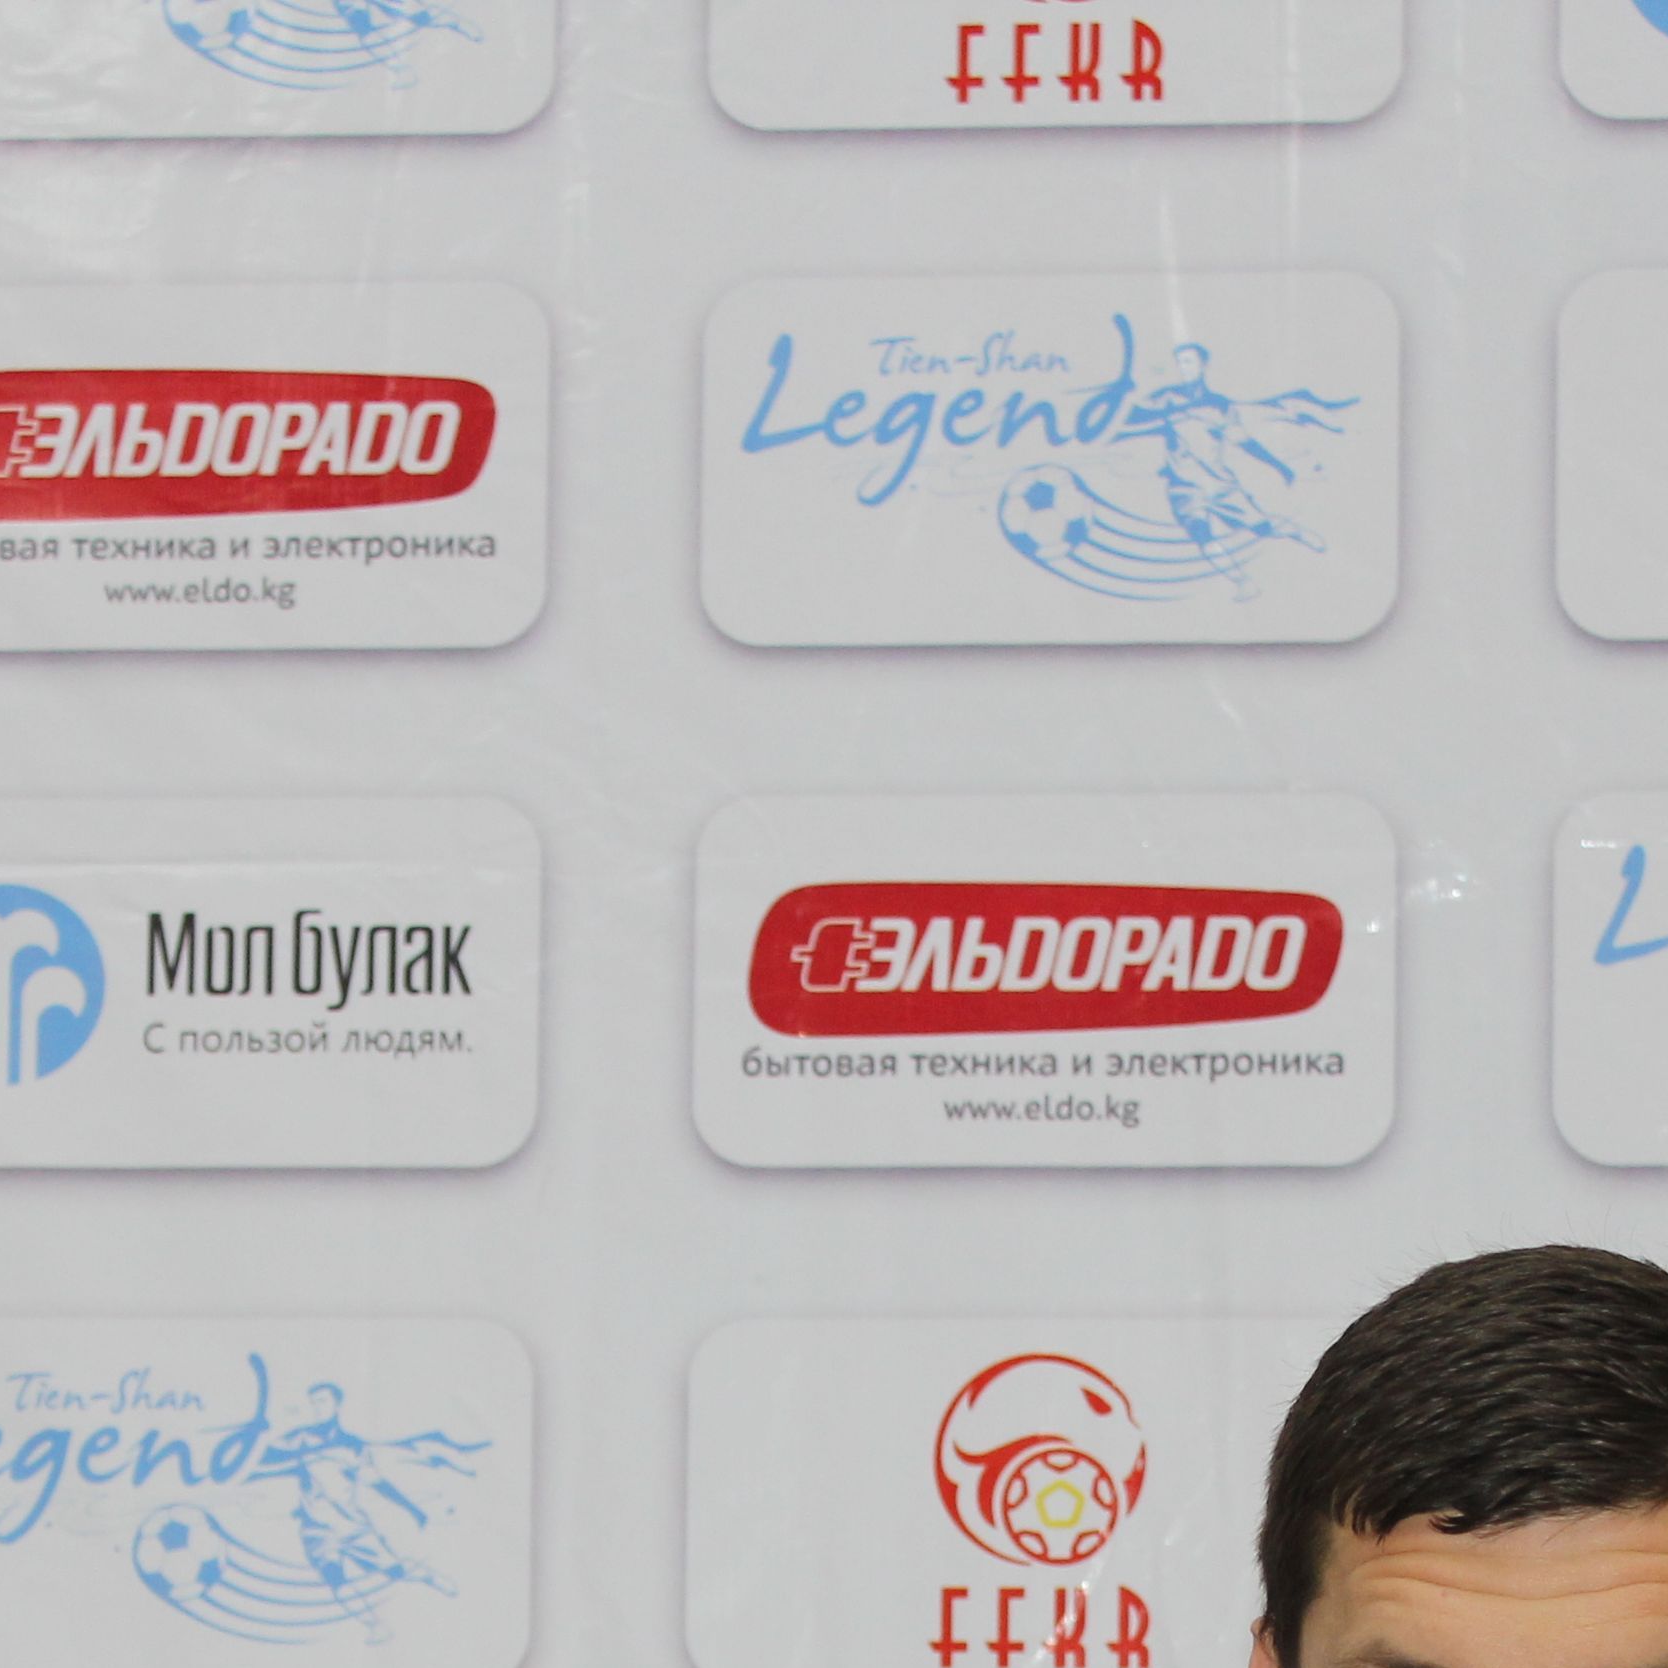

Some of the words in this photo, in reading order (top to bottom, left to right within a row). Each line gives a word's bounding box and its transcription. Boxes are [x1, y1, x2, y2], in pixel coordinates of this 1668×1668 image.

[946, 19, 1164, 104] FFKR
[870, 331, 1070, 377] Tien-Shan
[741, 313, 1135, 506] Legend
[71, 537, 218, 561] техника
[229, 538, 251, 559] и
[262, 535, 497, 566] электроника
[103, 576, 297, 610] www.eldo.kg
[147, 911, 275, 996] Мол
[142, 1021, 166, 1055] С
[178, 1021, 330, 1055] пользой
[341, 1028, 472, 1059] людям.
[741, 1045, 898, 1079] бытовая
[909, 1052, 1059, 1078] техника
[1071, 1053, 1093, 1076] и
[1106, 1051, 1345, 1082] электроника
[943, 1093, 1141, 1130] www.eldo.kg
[6, 1367, 205, 1414] Tien-Shan
